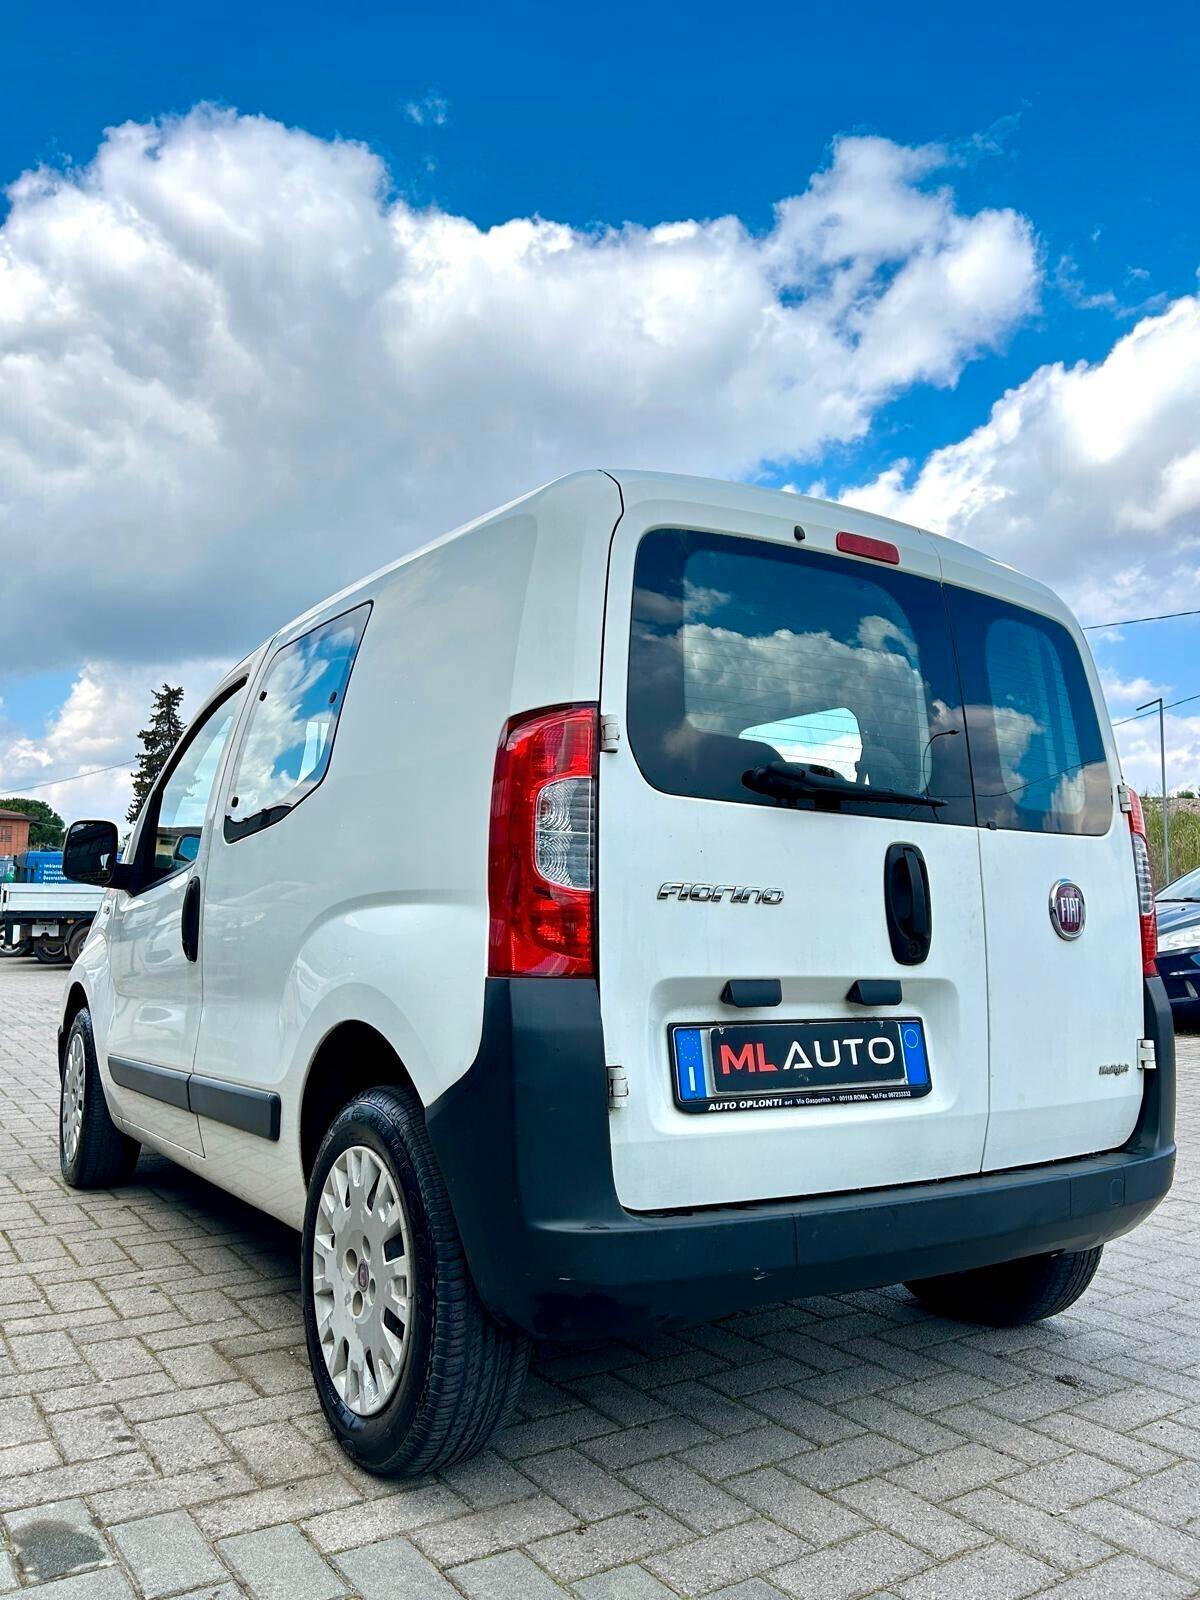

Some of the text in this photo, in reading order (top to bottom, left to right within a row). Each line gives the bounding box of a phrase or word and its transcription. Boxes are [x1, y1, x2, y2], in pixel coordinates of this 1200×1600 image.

[1060, 897, 1080, 923] FIAT
[719, 1037, 896, 1075] ML AUTO
[708, 1101, 737, 1111] AUTO
[739, 1098, 782, 1109] OPLONTI
